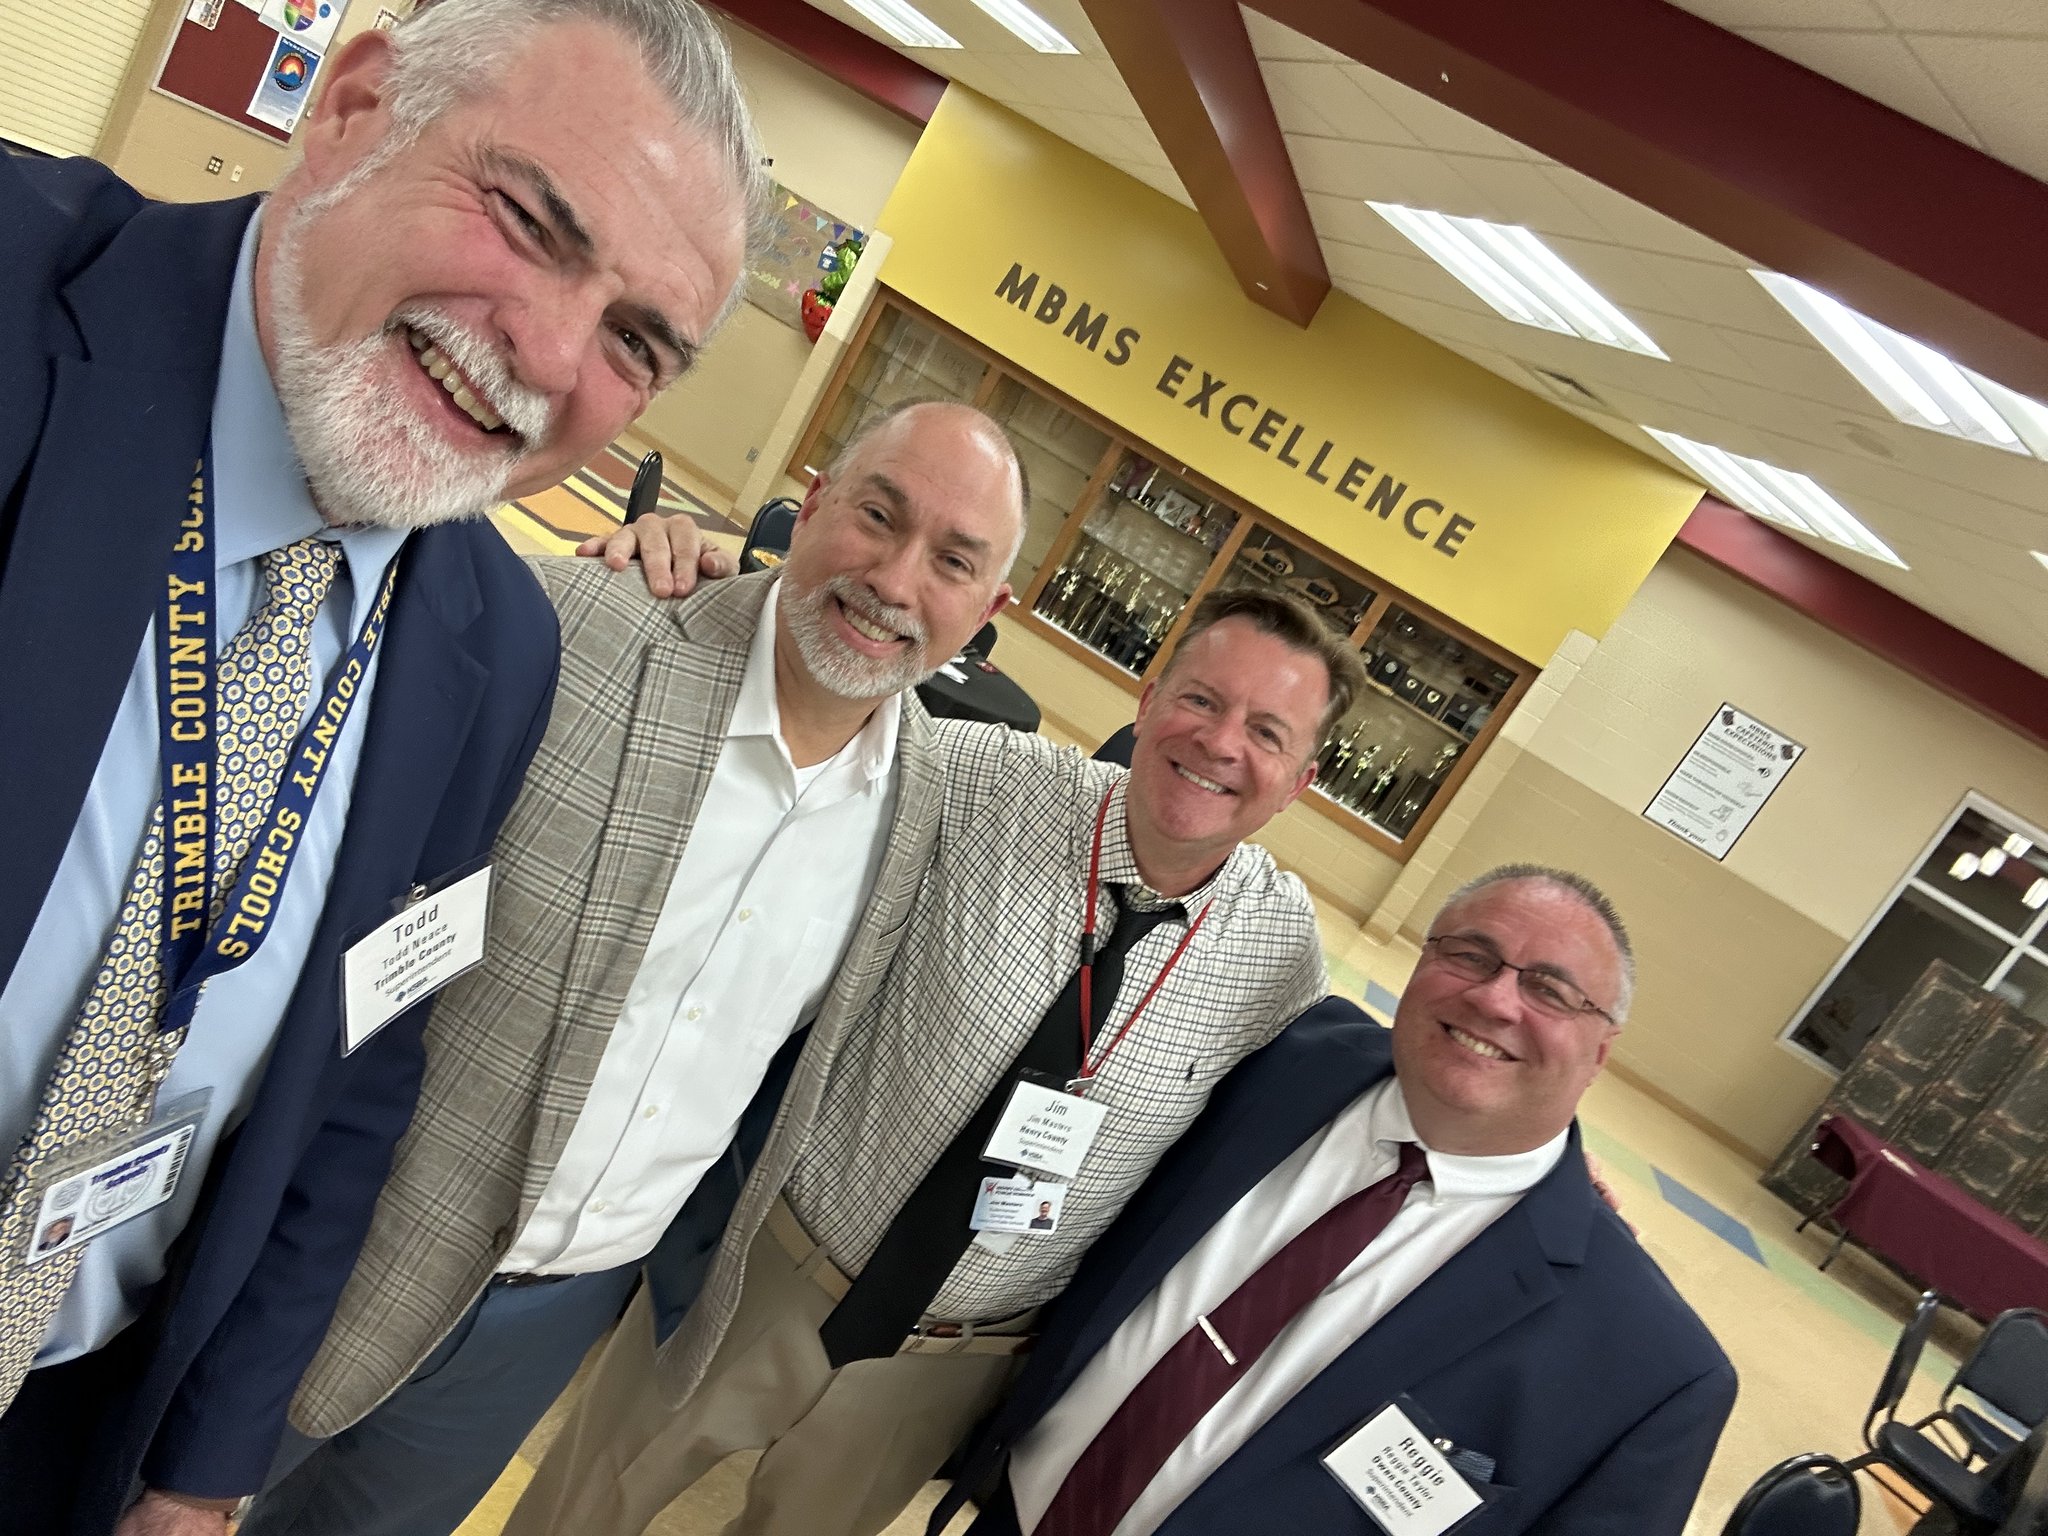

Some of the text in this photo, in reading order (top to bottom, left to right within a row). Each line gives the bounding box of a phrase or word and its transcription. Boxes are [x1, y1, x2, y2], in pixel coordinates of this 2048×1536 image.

[994, 262, 1477, 558] MBMS EXCELLENCE
[168, 573, 208, 743] COUNTY
[292, 657, 363, 798] COUNTY
[1724, 728, 1778, 761] EXPECTATIONS
[1736, 726, 1775, 751] CAFETERIA
[170, 761, 208, 941] TRIMBLE
[1667, 819, 1689, 835] Thank
[216, 806, 302, 960] SCHOOLS
[381, 923, 448, 970] Todd Neace
[392, 904, 439, 944] Todd
[373, 957, 416, 992] Trimble
[418, 932, 457, 961] County
[385, 948, 453, 998] Superintendent
[1027, 1114, 1073, 1133] Jim Masters
[1045, 1100, 1068, 1116] Jim
[1019, 1125, 1069, 1146] Henry County
[1372, 1455, 1396, 1482] Owen
[1394, 1479, 1423, 1511] County
[1382, 1446, 1410, 1476] Reggie
[1408, 1474, 1435, 1502] Taylor
[1398, 1436, 1445, 1488] Reggie
